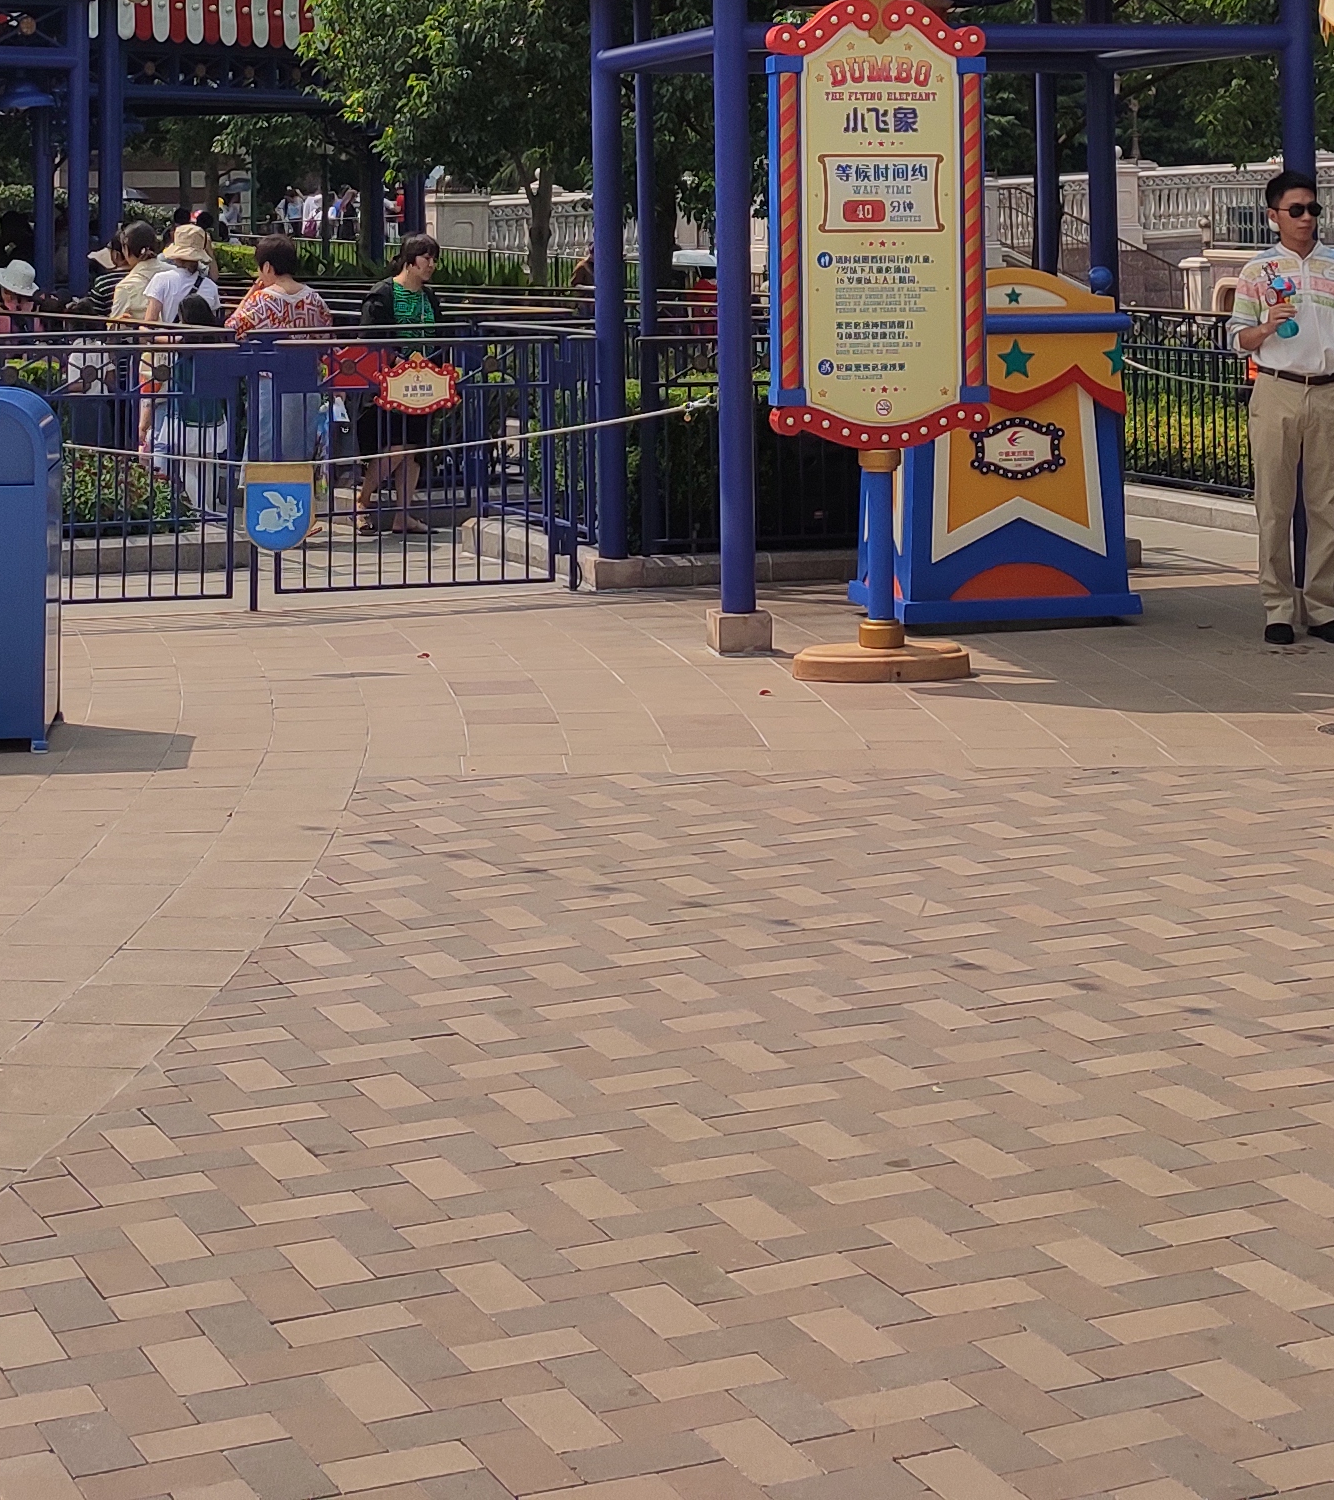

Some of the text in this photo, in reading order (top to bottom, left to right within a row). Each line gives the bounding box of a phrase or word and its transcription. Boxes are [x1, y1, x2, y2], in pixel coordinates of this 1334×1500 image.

[826, 54, 933, 89] DUMBO
[825, 91, 938, 102] THE FLYING ELEPHANT
[843, 106, 920, 134] 小飞象
[834, 163, 929, 183] 等候时间约
[852, 185, 912, 195] WAIT TIME
[856, 205, 872, 219] 40
[889, 200, 915, 214] 分钟
